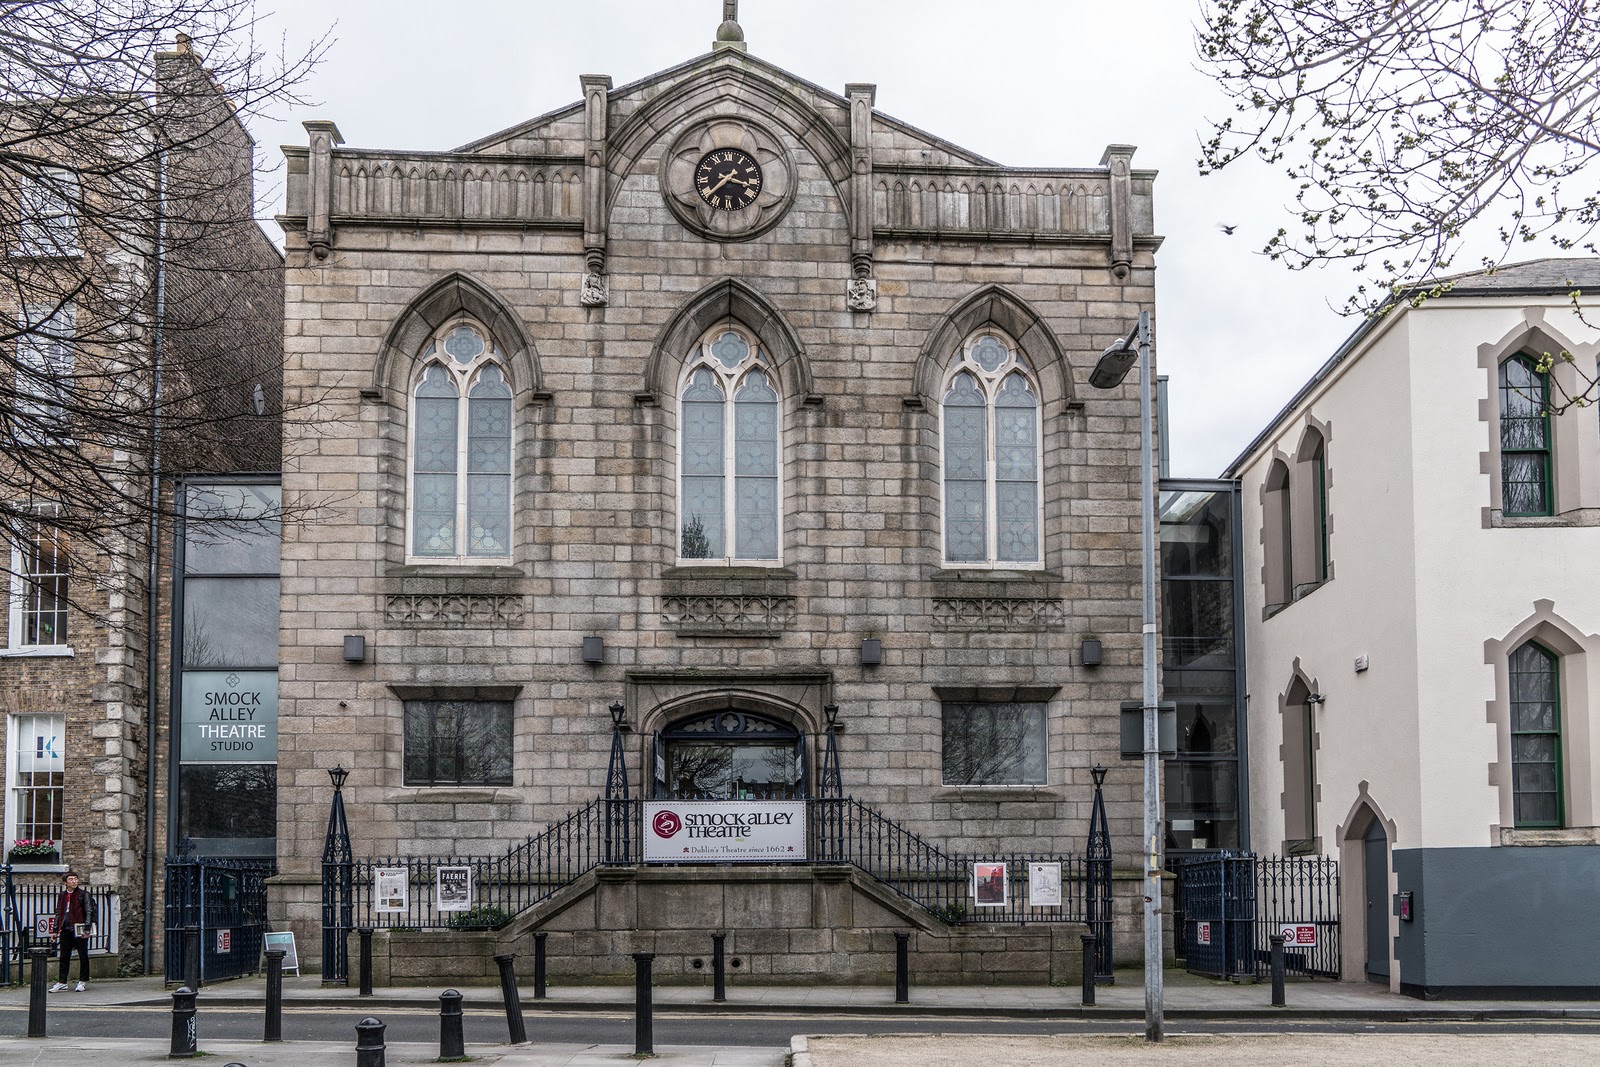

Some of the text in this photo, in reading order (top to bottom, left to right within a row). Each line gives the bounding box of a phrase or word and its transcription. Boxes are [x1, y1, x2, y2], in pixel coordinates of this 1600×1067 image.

[205, 692, 261, 705] SMOCK
[209, 708, 256, 720] ALLEY
[198, 725, 266, 738] THEATRE
[211, 741, 254, 751] STUDIO
[691, 845, 719, 853] Dublin's
[721, 845, 747, 853] Theatre
[766, 845, 785, 853] 1662
[442, 872, 466, 880] FAERIE
